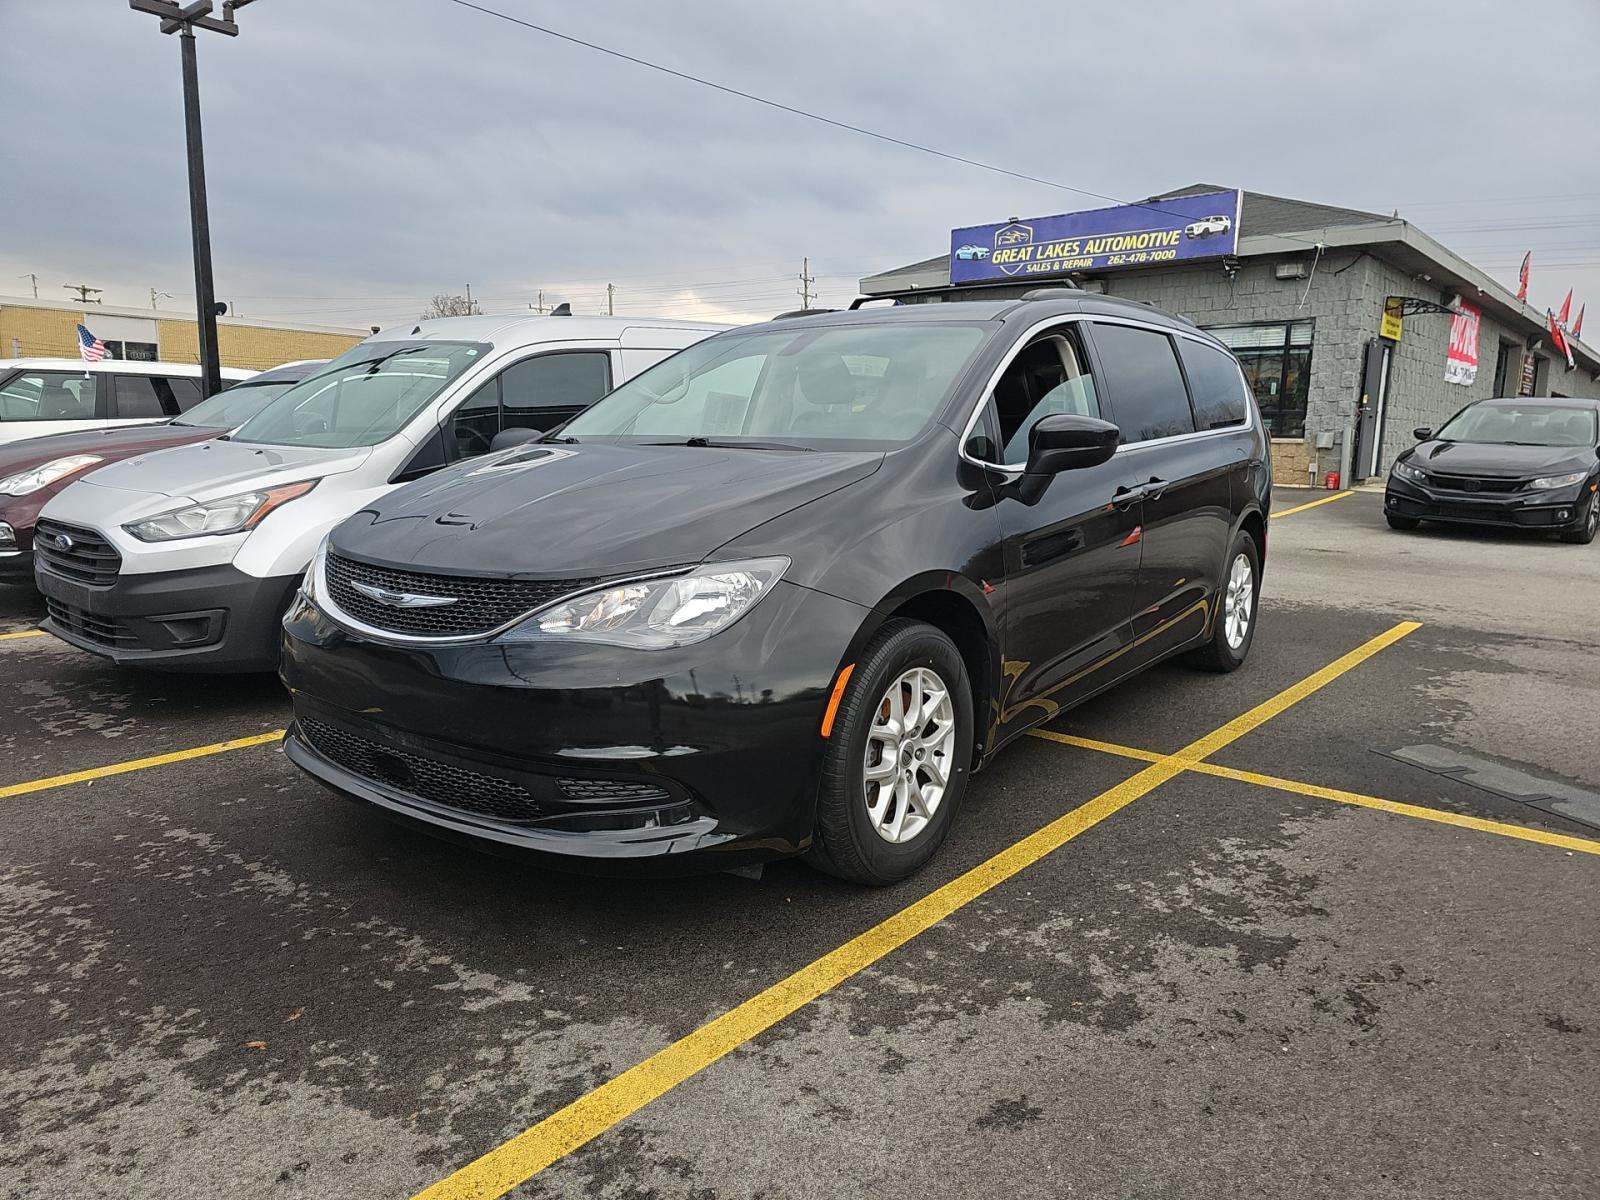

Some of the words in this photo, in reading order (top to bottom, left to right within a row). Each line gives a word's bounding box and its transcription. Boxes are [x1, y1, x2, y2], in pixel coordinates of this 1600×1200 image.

[992, 246, 1035, 264] GREAT
[1036, 241, 1081, 260] LAKES
[1083, 230, 1182, 254] AUTOMOTIVE
[1026, 262, 1052, 273] SALES
[1053, 261, 1060, 270] &
[1061, 257, 1094, 270] REPAIR
[1107, 249, 1177, 265] 262-478-7000
